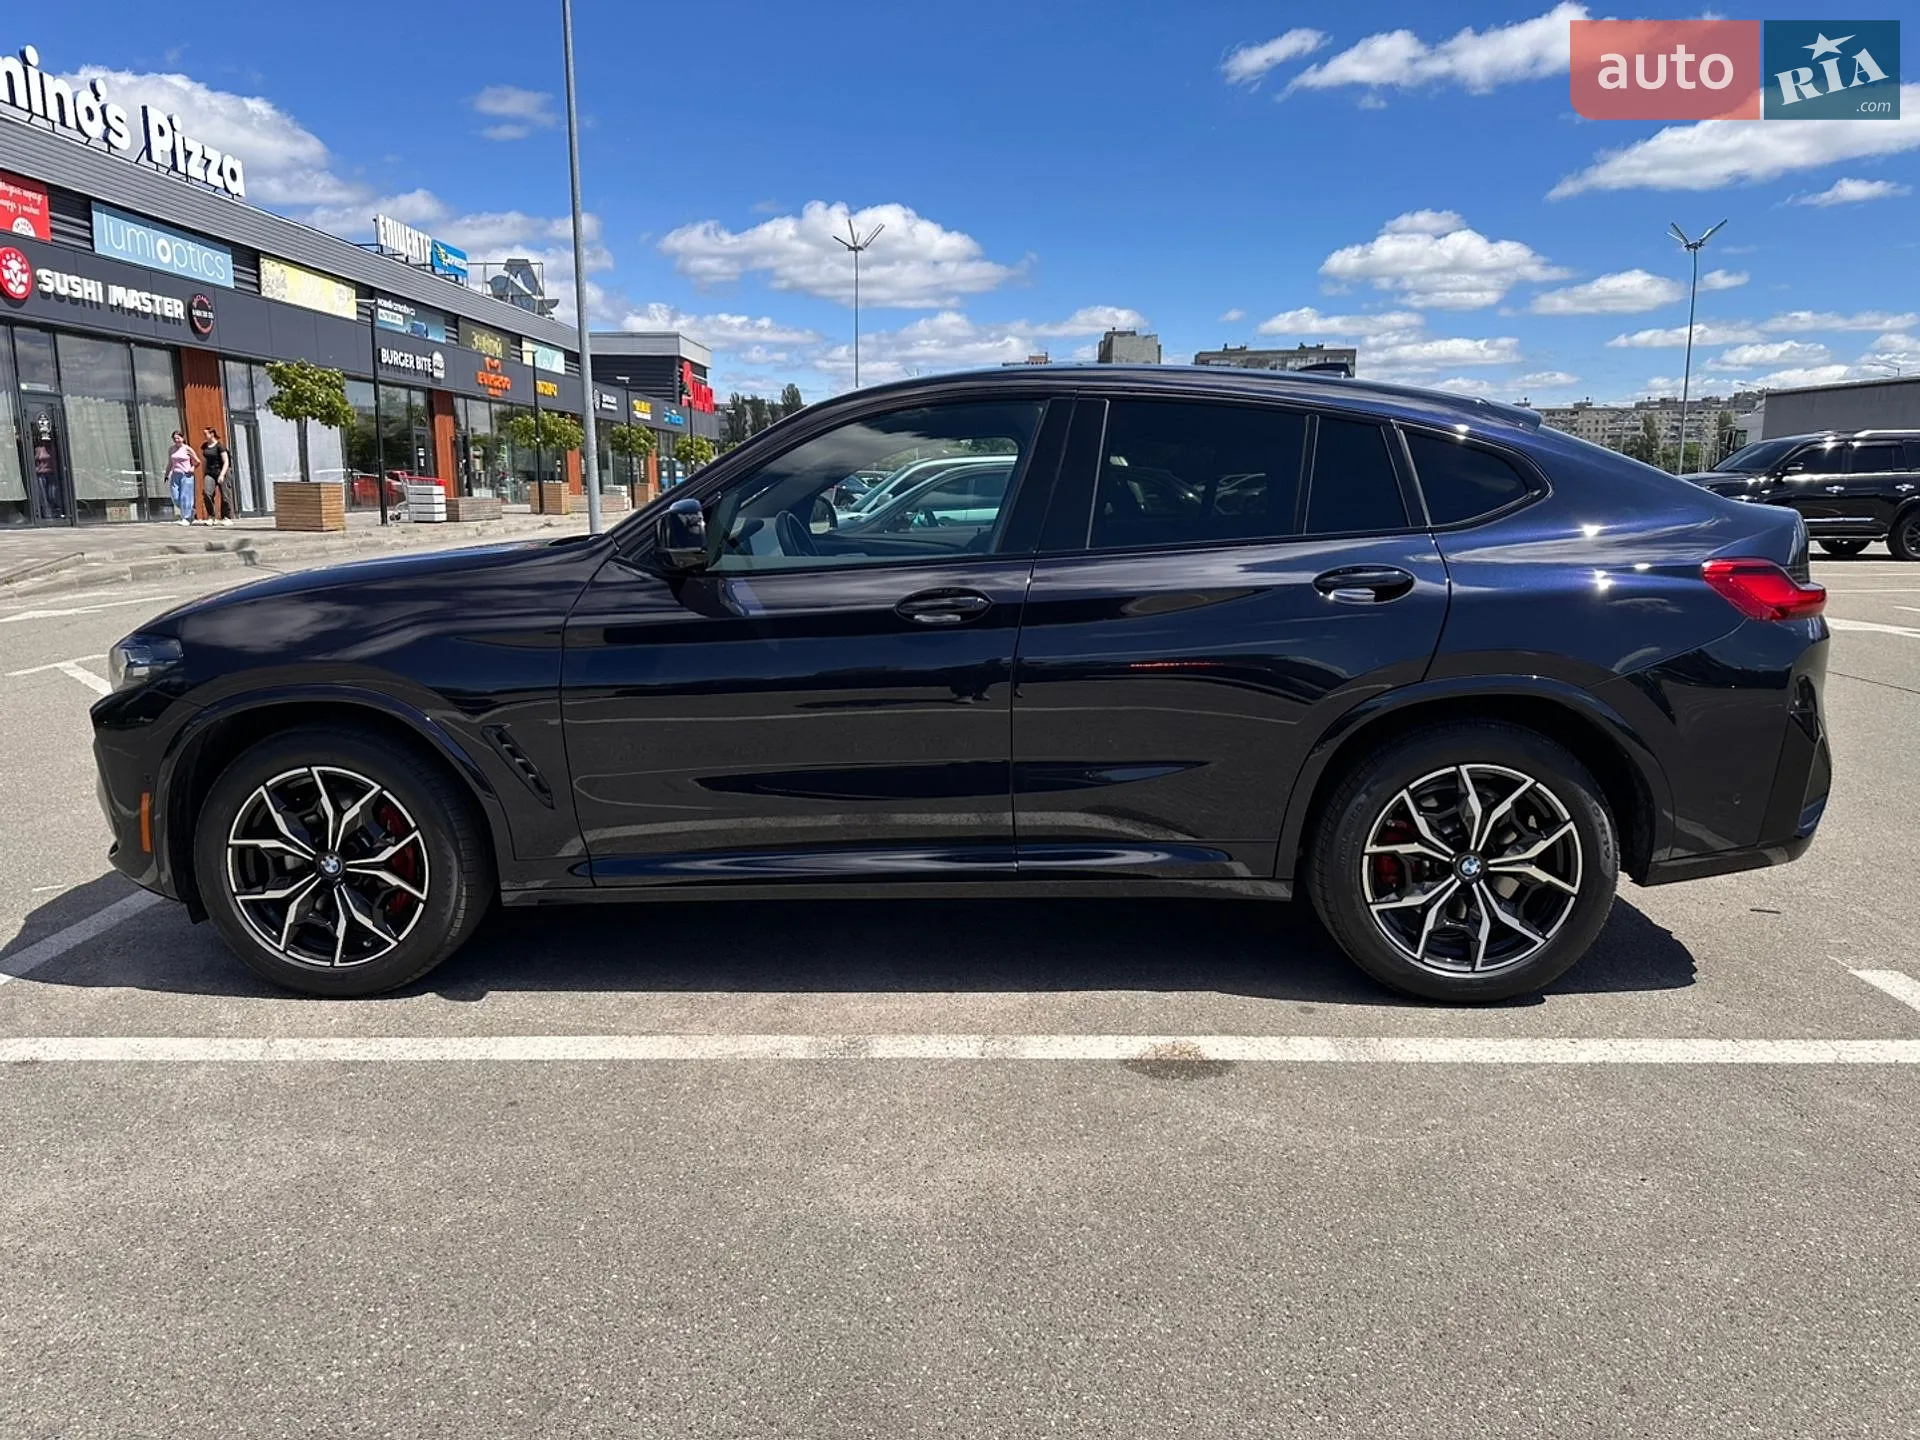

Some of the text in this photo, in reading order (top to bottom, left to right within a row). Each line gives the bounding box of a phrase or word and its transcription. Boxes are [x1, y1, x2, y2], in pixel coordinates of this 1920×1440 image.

[142, 104, 246, 198] Pizza
[102, 211, 226, 280] lumioptics
[36, 268, 104, 304] SUSHI
[108, 285, 185, 320] MASTER
[381, 348, 415, 369] BURGER
[416, 356, 433, 372] BITE
